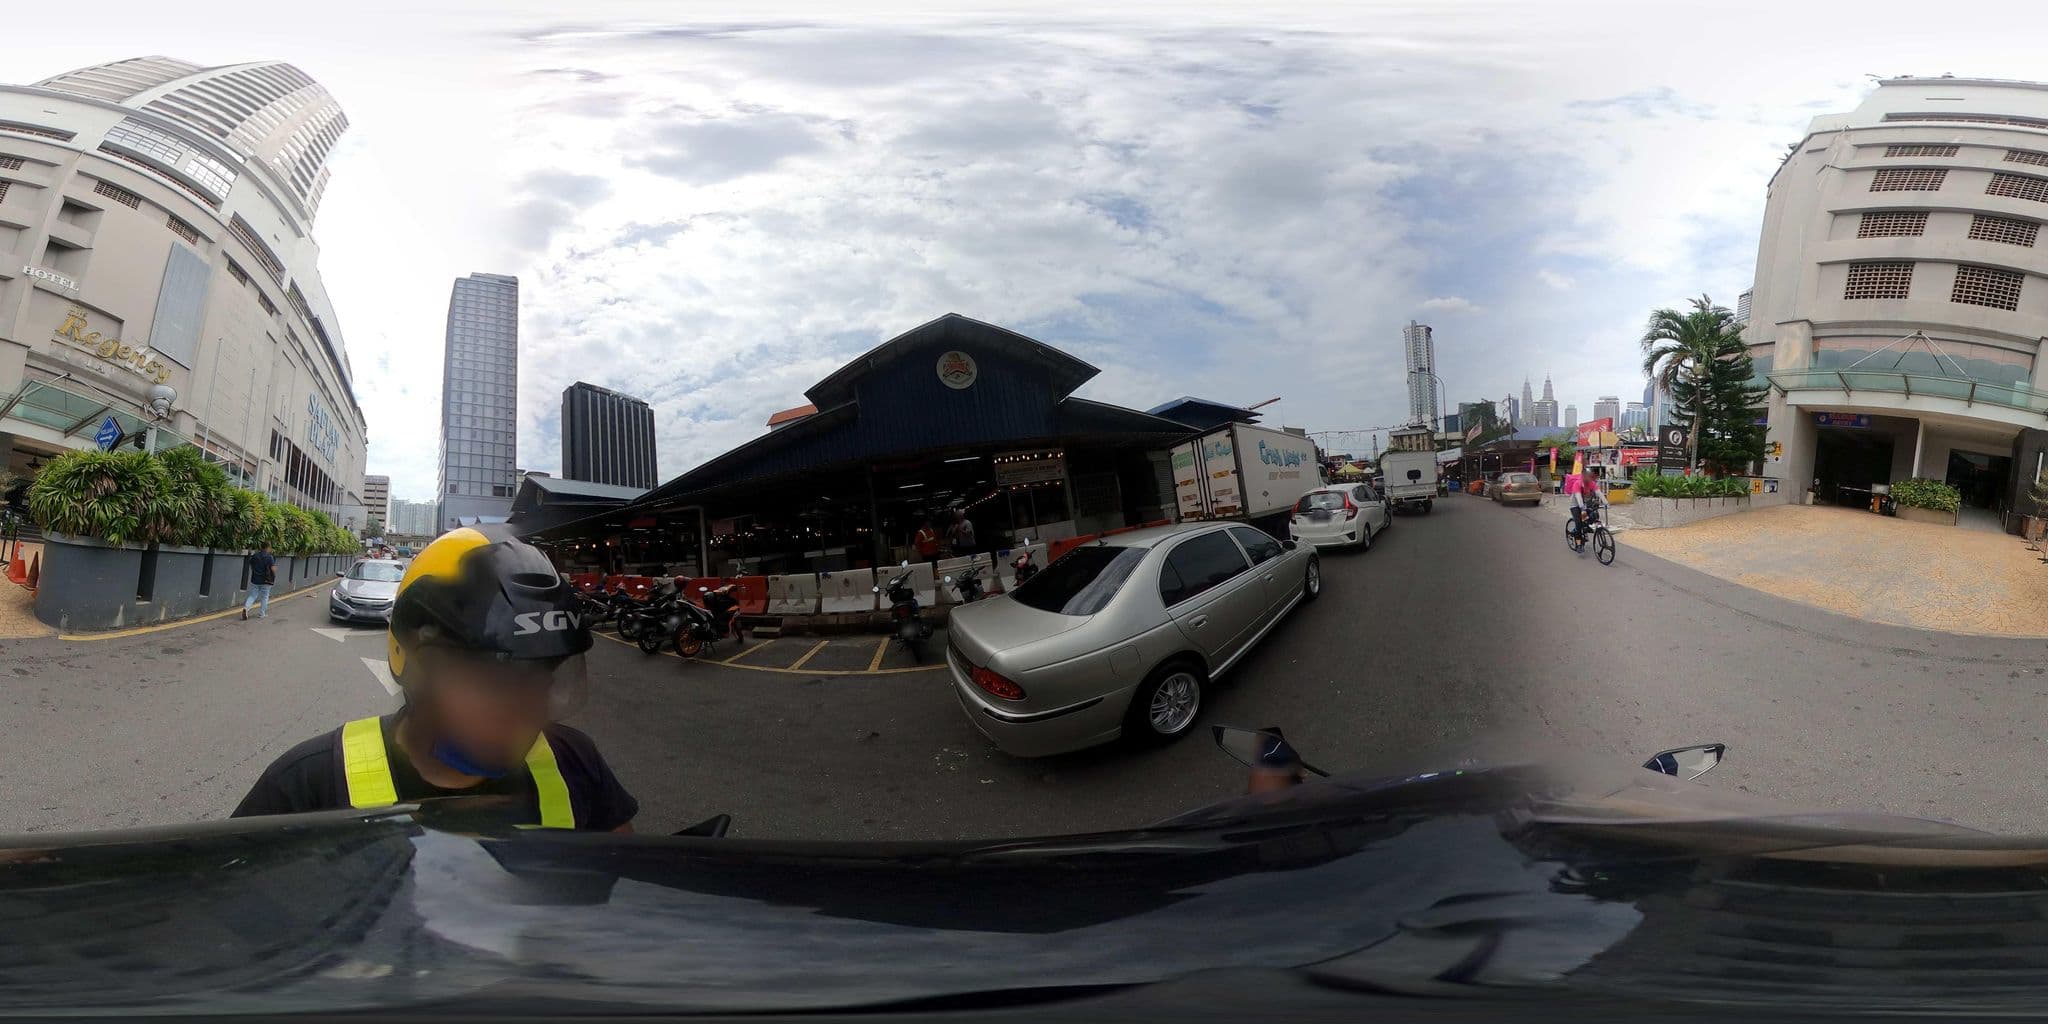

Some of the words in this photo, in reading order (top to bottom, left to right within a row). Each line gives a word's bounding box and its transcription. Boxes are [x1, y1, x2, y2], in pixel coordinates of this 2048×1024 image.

[23, 266, 79, 291] HOTEL
[54, 315, 171, 384] Regency
[513, 610, 582, 636] SGV
